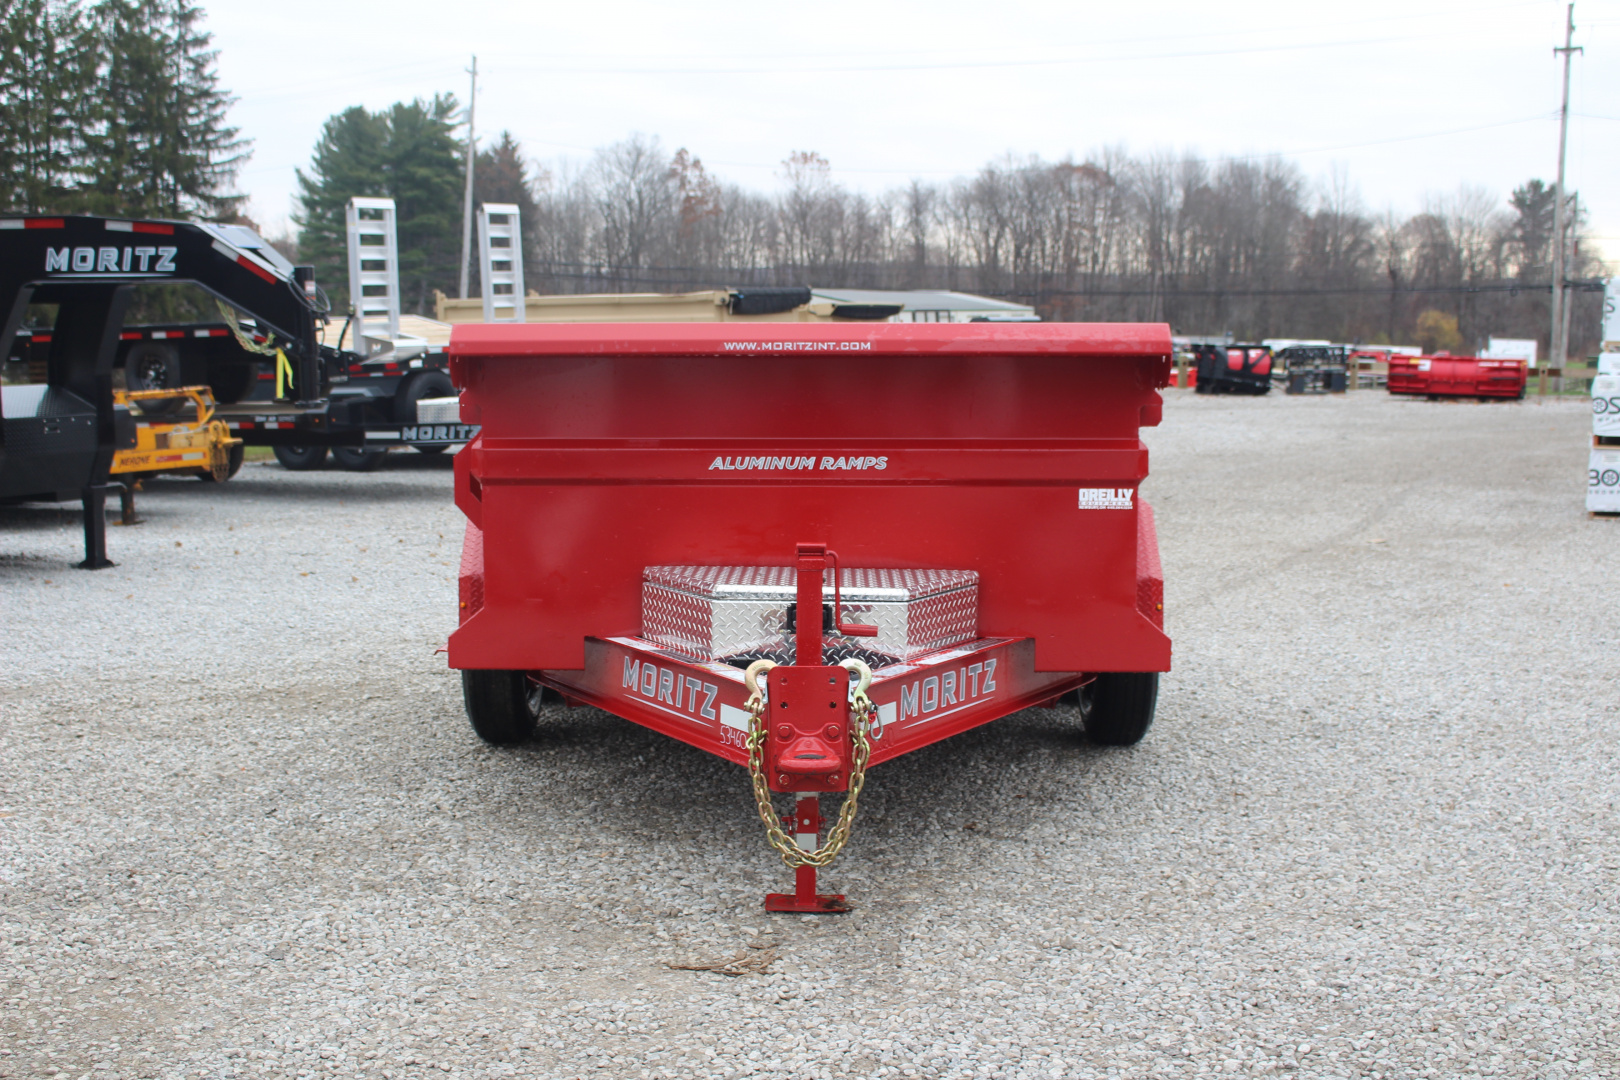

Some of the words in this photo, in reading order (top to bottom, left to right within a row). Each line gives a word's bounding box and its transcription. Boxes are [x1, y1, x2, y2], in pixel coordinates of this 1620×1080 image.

[45, 246, 178, 273] MORITZ
[724, 342, 871, 351] WWW.MORITZINT.COM
[709, 456, 816, 470] ALUMINUM
[819, 456, 888, 470] RAMPS
[1589, 468, 1620, 487] BO
[622, 656, 718, 721] MORITZ
[900, 658, 997, 721] MORITZ
[719, 725, 747, 750] 53460
